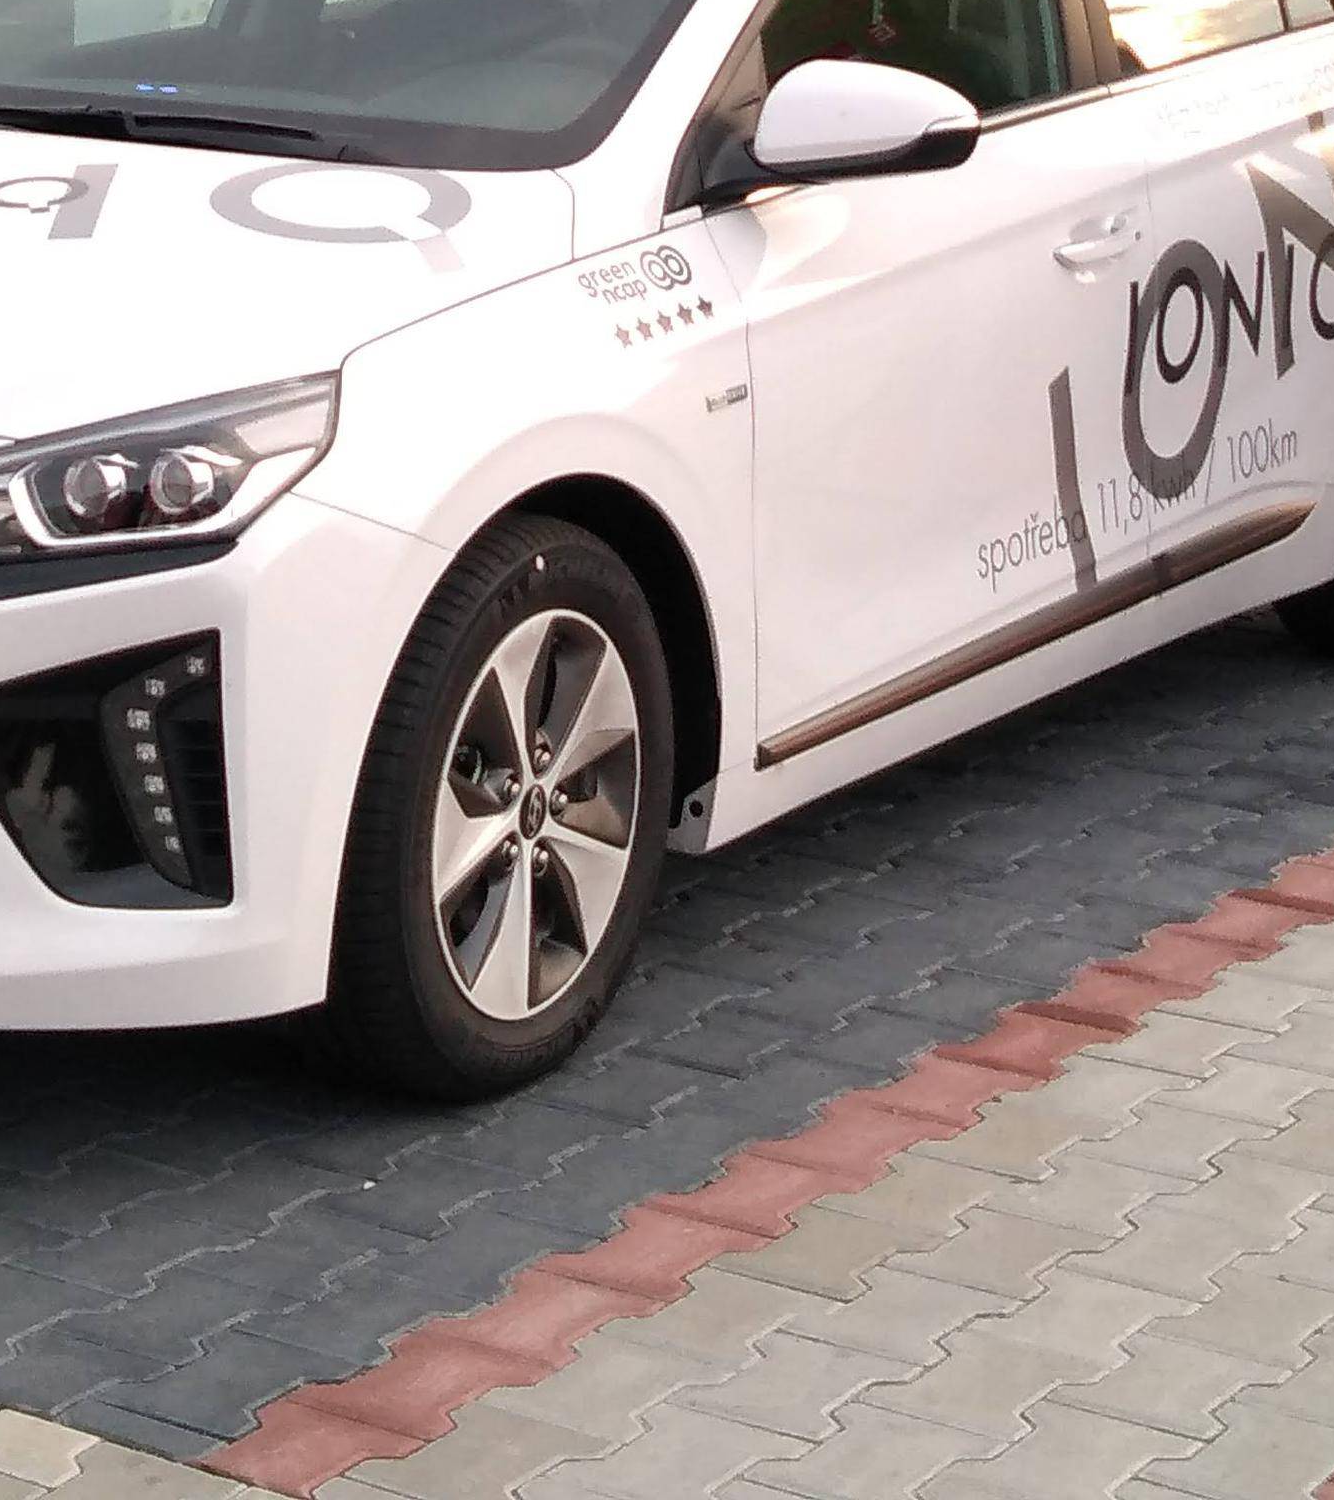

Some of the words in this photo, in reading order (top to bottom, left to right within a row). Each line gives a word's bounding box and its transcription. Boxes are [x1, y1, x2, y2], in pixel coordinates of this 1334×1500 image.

[578, 259, 636, 298] green
[602, 278, 648, 304] ncap
[976, 493, 1088, 594] spotřeba
[1096, 472, 1143, 536] 11,8
[1226, 417, 1298, 483] 100km
